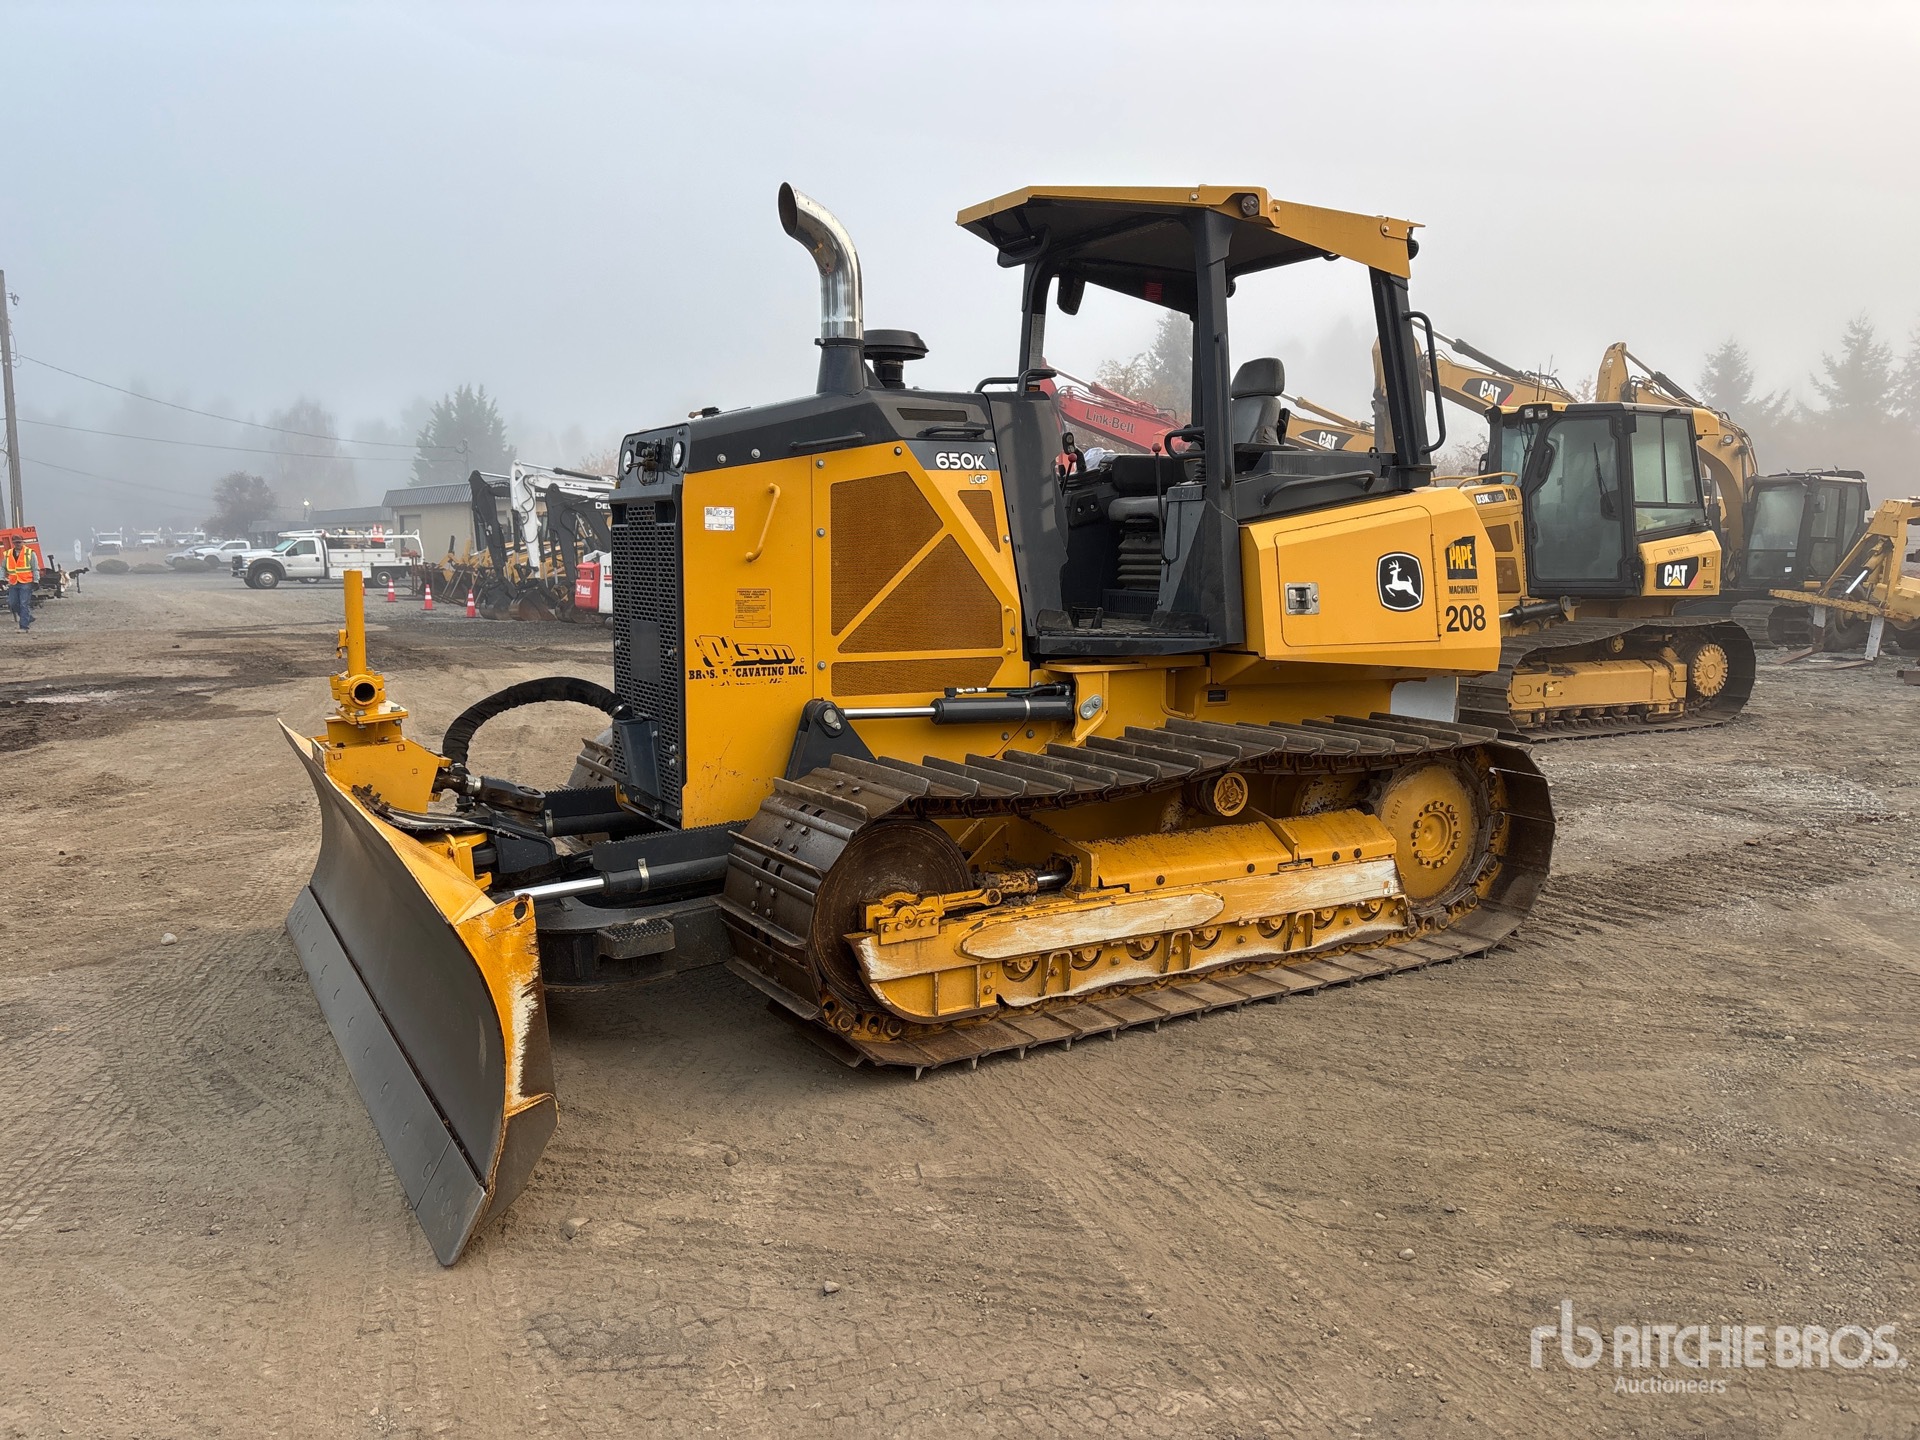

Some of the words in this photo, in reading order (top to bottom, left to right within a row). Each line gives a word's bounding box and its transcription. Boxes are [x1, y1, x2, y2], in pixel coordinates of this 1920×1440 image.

[1479, 380, 1502, 405] CAT
[1085, 407, 1134, 434] Link-Belt
[1318, 431, 1338, 449] CAT
[935, 452, 987, 470] 650K
[969, 474, 988, 484] LGP
[1664, 564, 1688, 586] CAT
[1448, 585, 1478, 594] MACHINERY
[1445, 604, 1486, 632] 208
[788, 665, 807, 675] INC.
